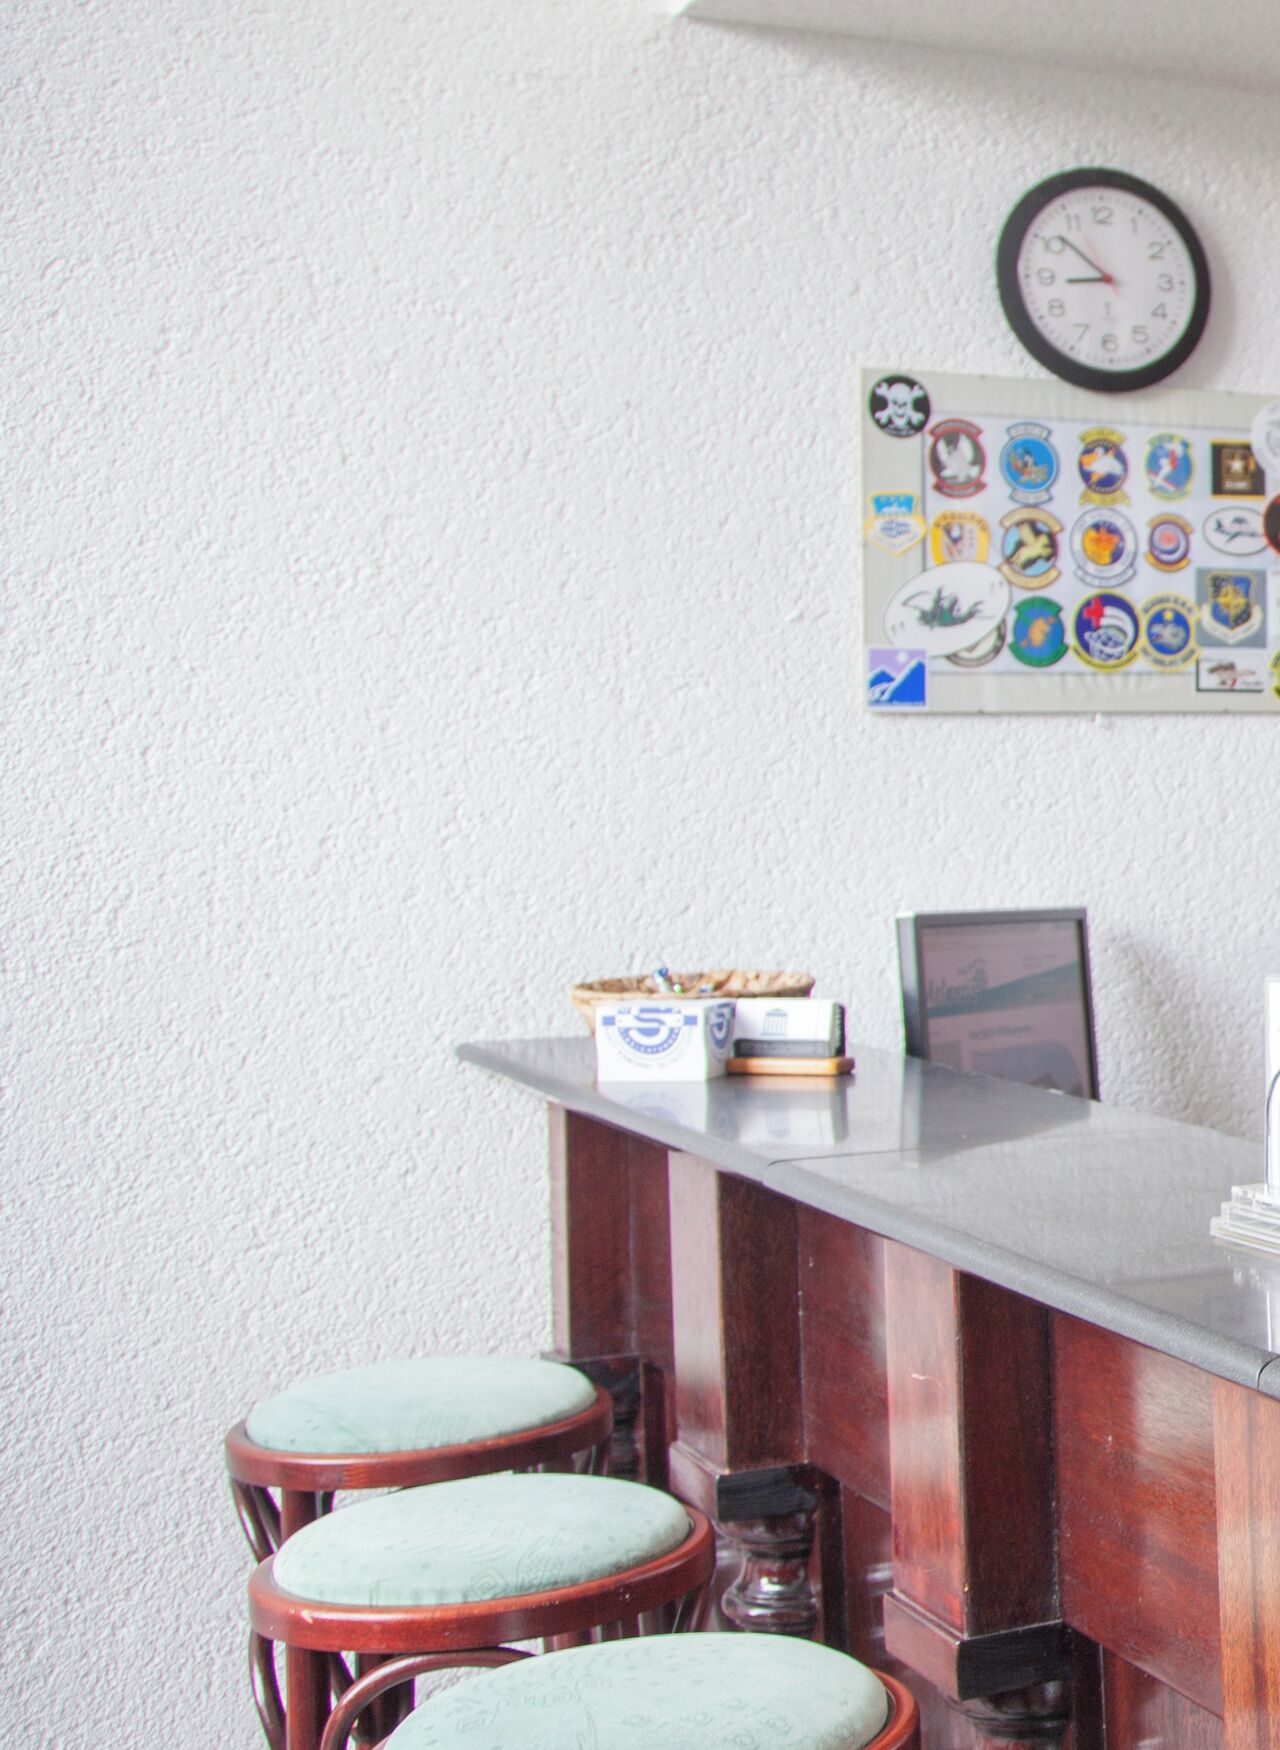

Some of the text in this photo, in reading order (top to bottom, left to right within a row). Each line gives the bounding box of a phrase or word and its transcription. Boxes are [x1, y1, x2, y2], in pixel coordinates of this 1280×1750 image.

[1065, 214, 1082, 232] 11
[1091, 205, 1114, 225] 12
[1130, 217, 1138, 235] 1
[1148, 242, 1165, 260] 2
[1036, 267, 1056, 287] 9
[1157, 273, 1175, 292] 3
[1048, 298, 1066, 318] 8
[1151, 302, 1168, 320] 4
[1072, 323, 1090, 342] 7
[1131, 325, 1149, 344] 5
[1101, 333, 1119, 352] 6
